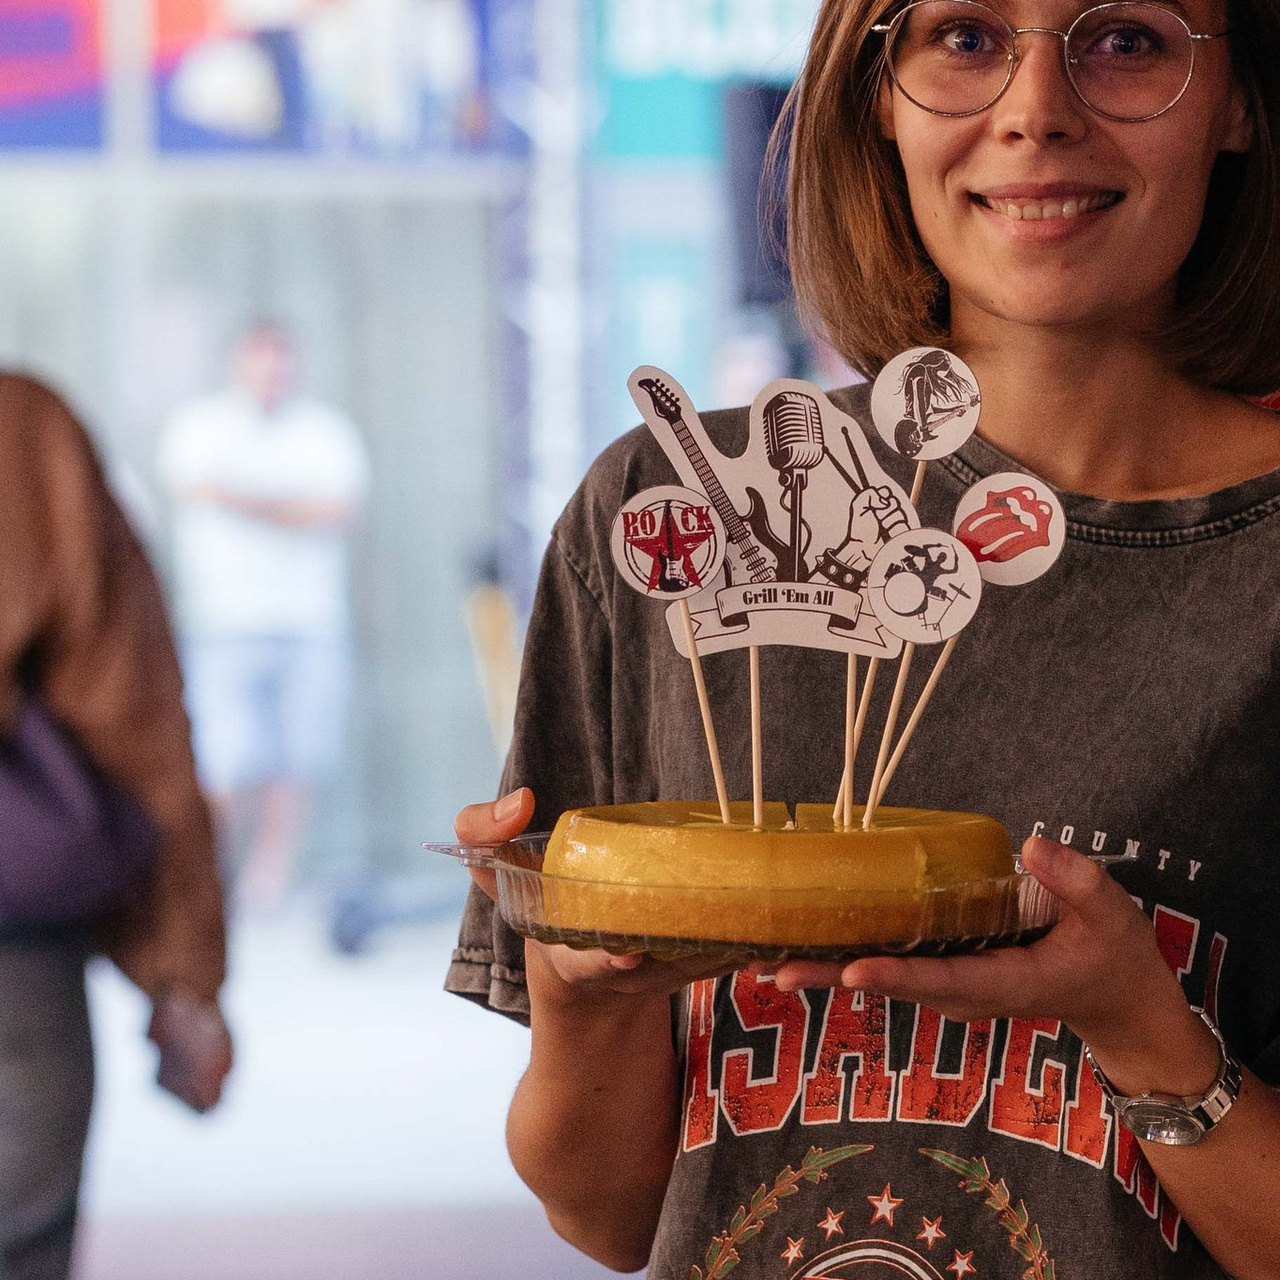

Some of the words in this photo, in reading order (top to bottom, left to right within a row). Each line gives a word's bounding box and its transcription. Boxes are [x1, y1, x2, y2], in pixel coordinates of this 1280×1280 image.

[621, 505, 716, 537] ROCK
[742, 587, 778, 606] Grill
[812, 590, 835, 607] All
[1032, 821, 1202, 881] COUNTY
